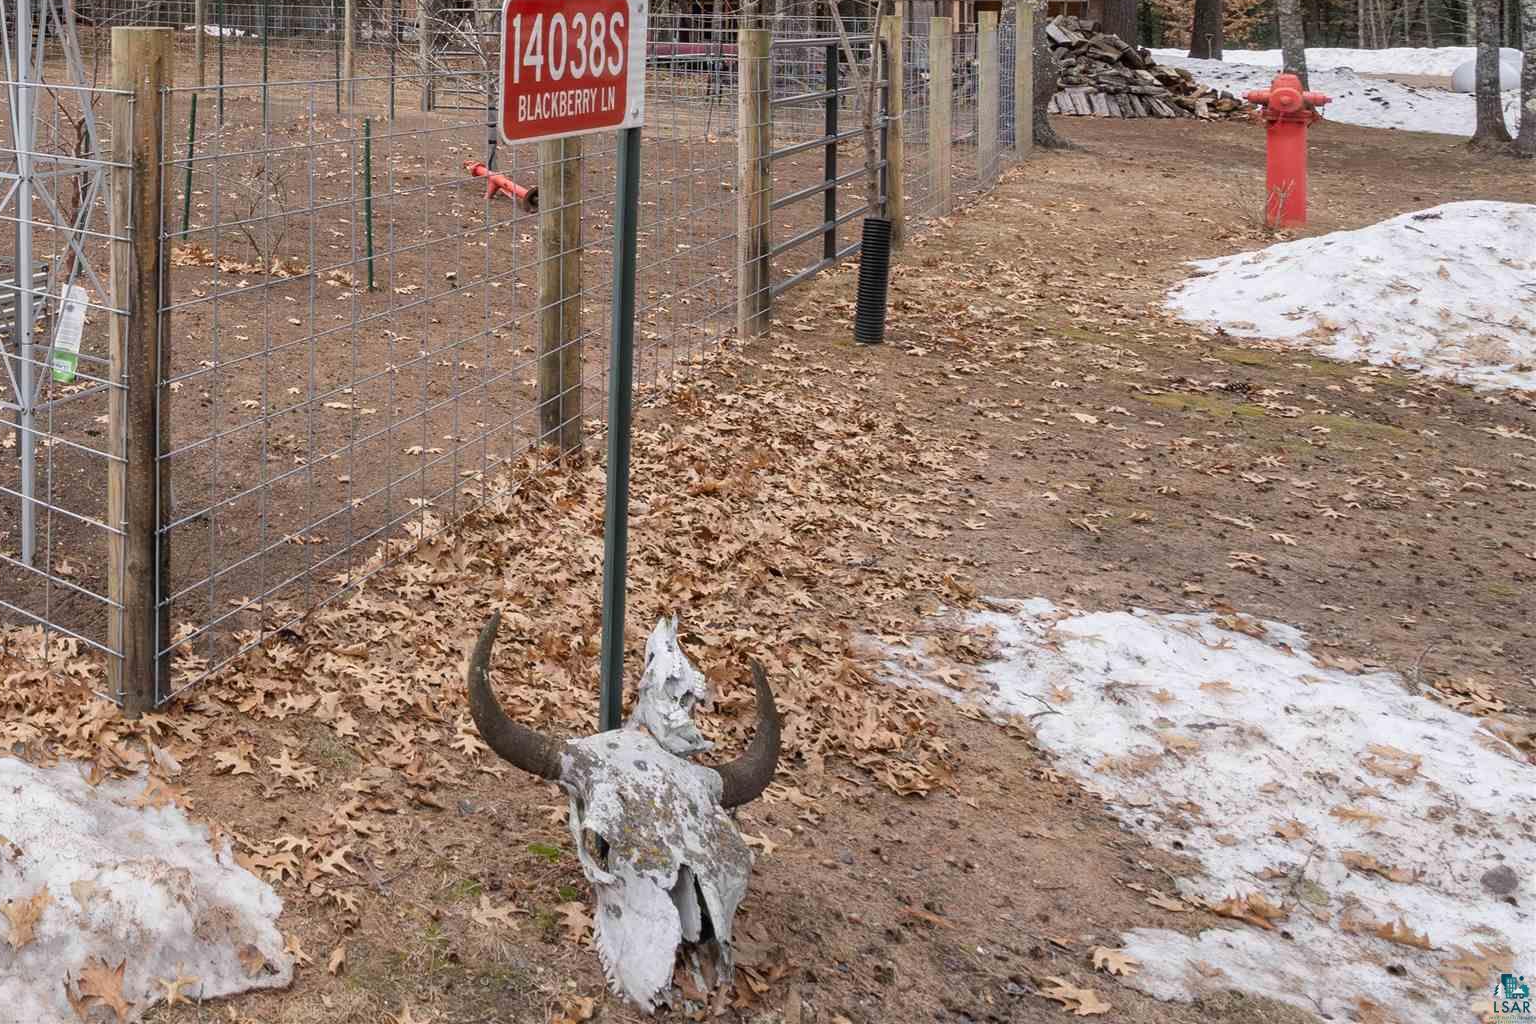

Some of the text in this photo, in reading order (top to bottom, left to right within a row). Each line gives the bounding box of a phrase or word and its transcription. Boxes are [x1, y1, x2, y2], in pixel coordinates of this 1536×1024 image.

[512, 11, 625, 84] 14038S
[517, 85, 616, 123] BLACKBERRY LN
